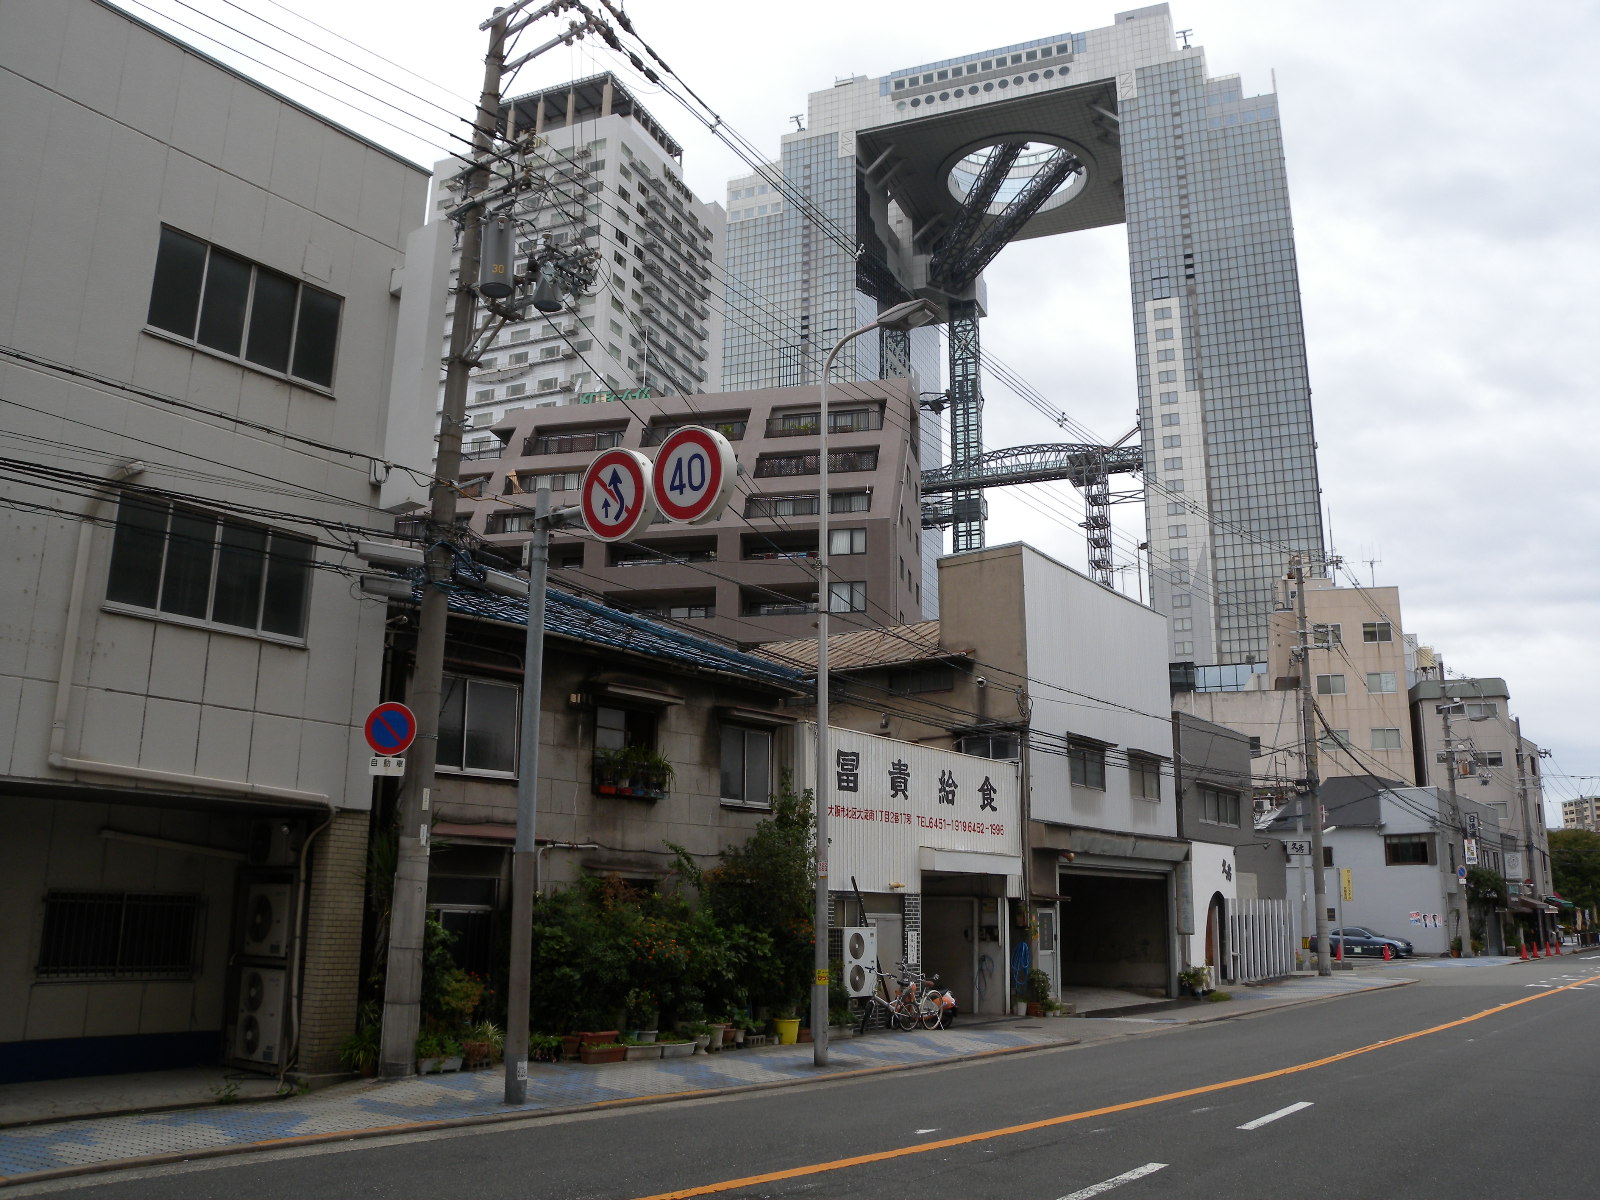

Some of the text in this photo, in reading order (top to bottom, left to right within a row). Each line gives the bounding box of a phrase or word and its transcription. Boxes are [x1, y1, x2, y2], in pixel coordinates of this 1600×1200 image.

[491, 263, 505, 274] 30
[669, 453, 706, 496] 40
[370, 758, 404, 768] 自動車
